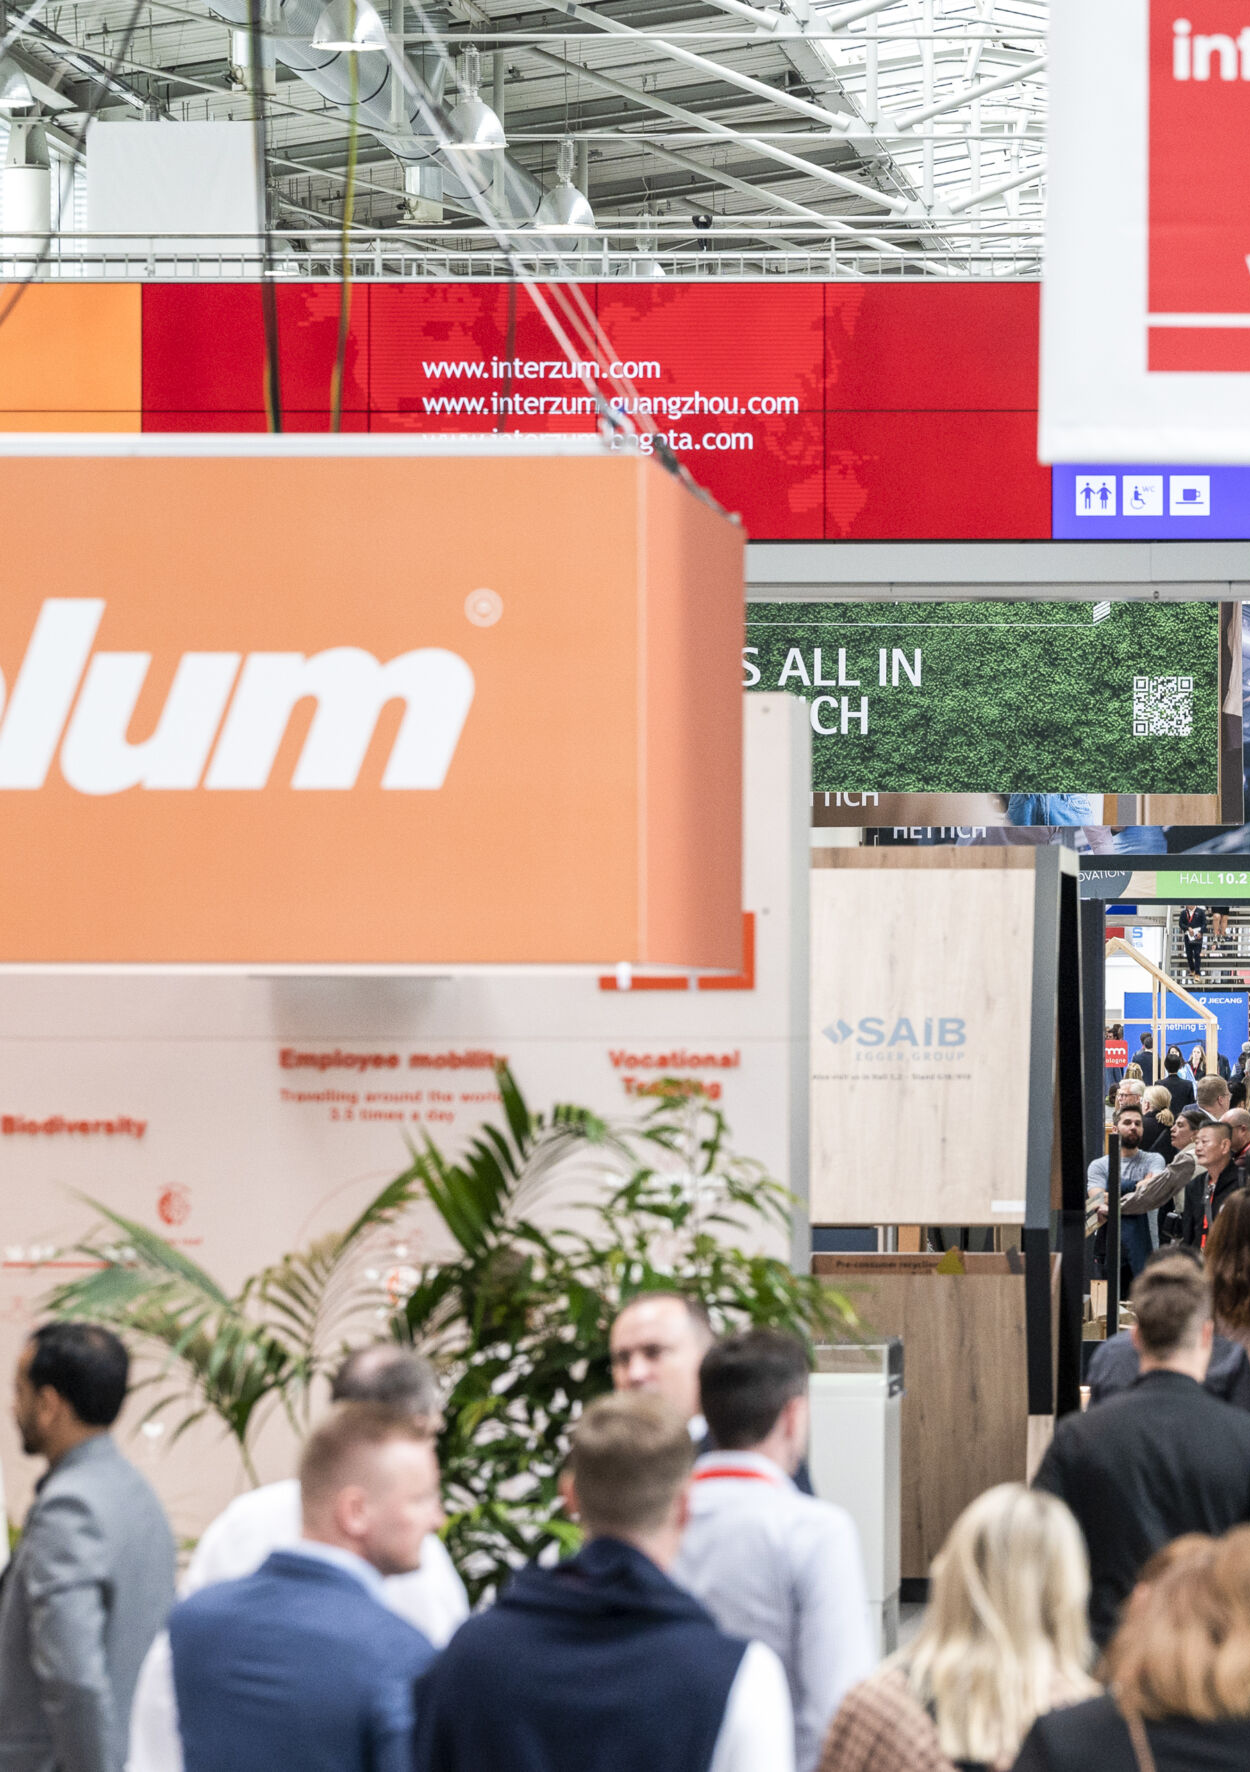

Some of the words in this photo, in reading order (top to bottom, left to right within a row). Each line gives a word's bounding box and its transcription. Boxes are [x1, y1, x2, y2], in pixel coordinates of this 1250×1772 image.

[422, 356, 661, 379] www.interzum.com
[422, 391, 799, 420] www.interzumguangzhou.com
[777, 648, 860, 687] ALL
[878, 648, 922, 687] IN
[0, 597, 475, 796] lum
[1179, 873, 1214, 885] HALL
[1217, 873, 1248, 885] 10.2
[279, 1049, 399, 1072] Employee
[608, 1049, 741, 1069] Vocational
[912, 1051, 965, 1061] GROUP
[1, 1115, 147, 1139] Biodiversity
